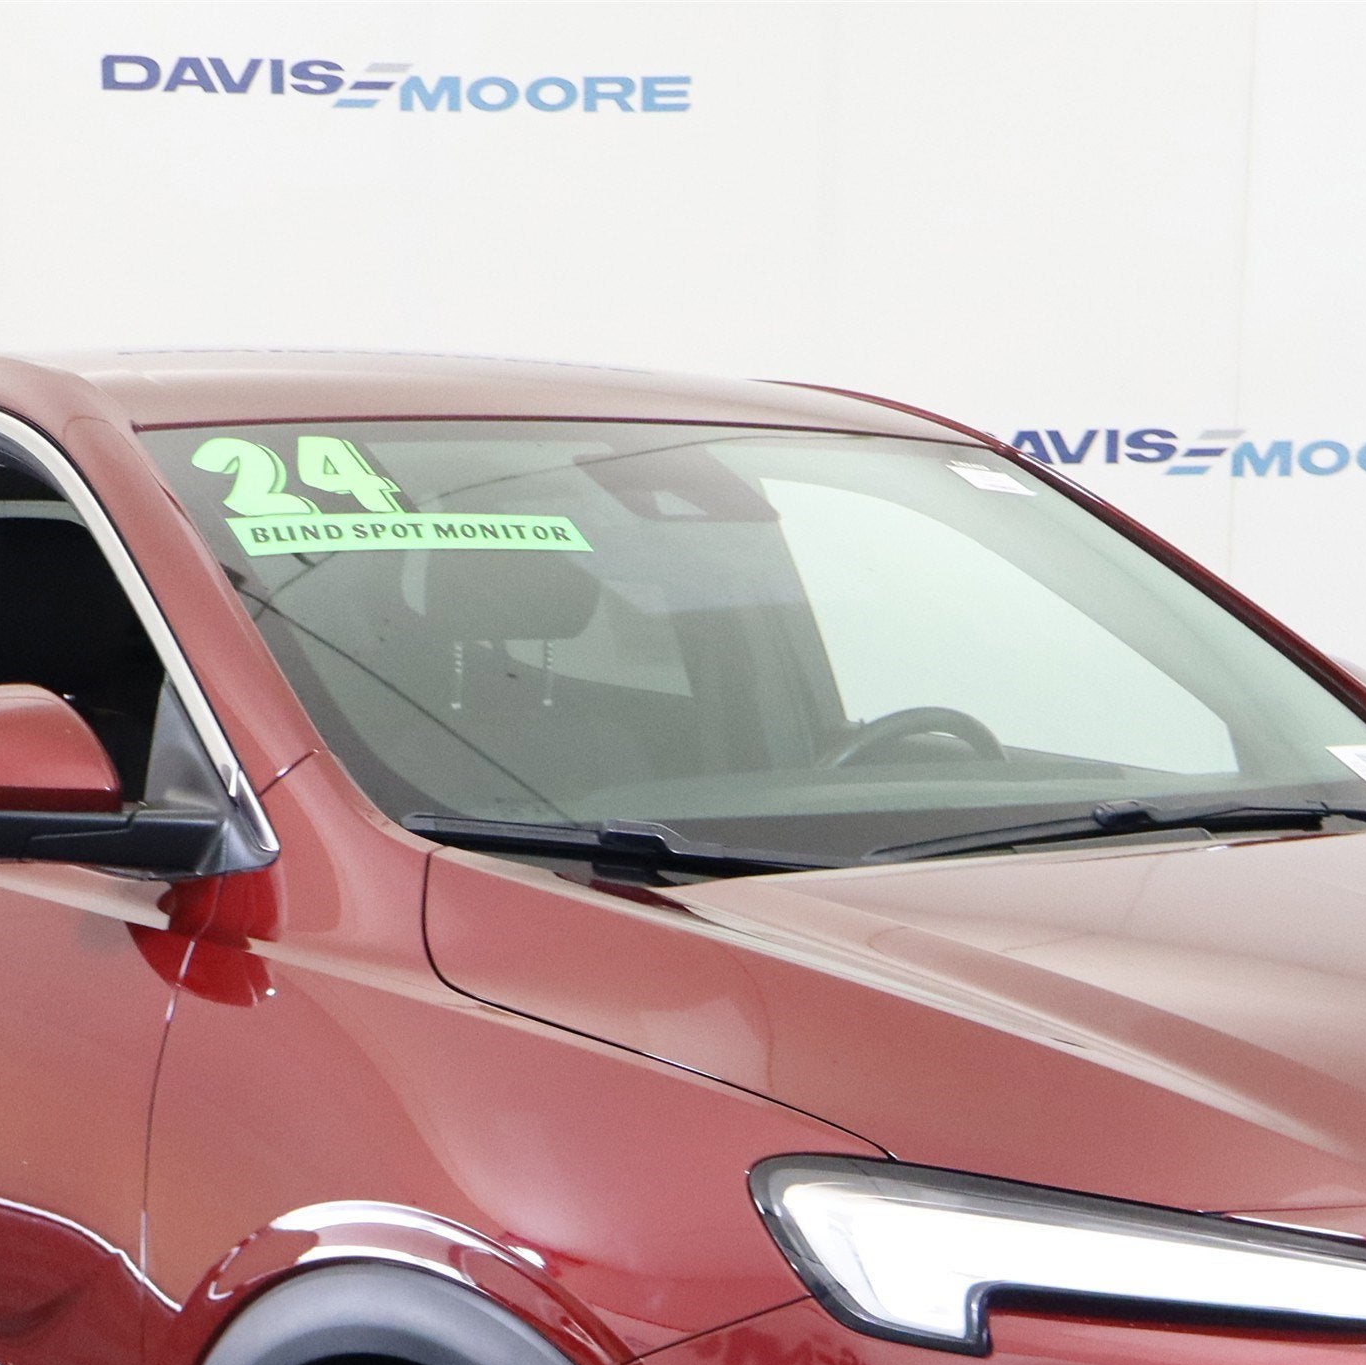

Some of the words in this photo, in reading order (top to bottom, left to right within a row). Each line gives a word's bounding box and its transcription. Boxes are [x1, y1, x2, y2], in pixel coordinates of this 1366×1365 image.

[101, 54, 345, 95] DAVIS
[399, 75, 691, 112] MOORE
[987, 429, 1178, 465] AVIS
[190, 436, 404, 515] 24
[251, 524, 344, 543] BLIND
[354, 522, 424, 539] SPOT
[434, 522, 573, 542] MONITOR
